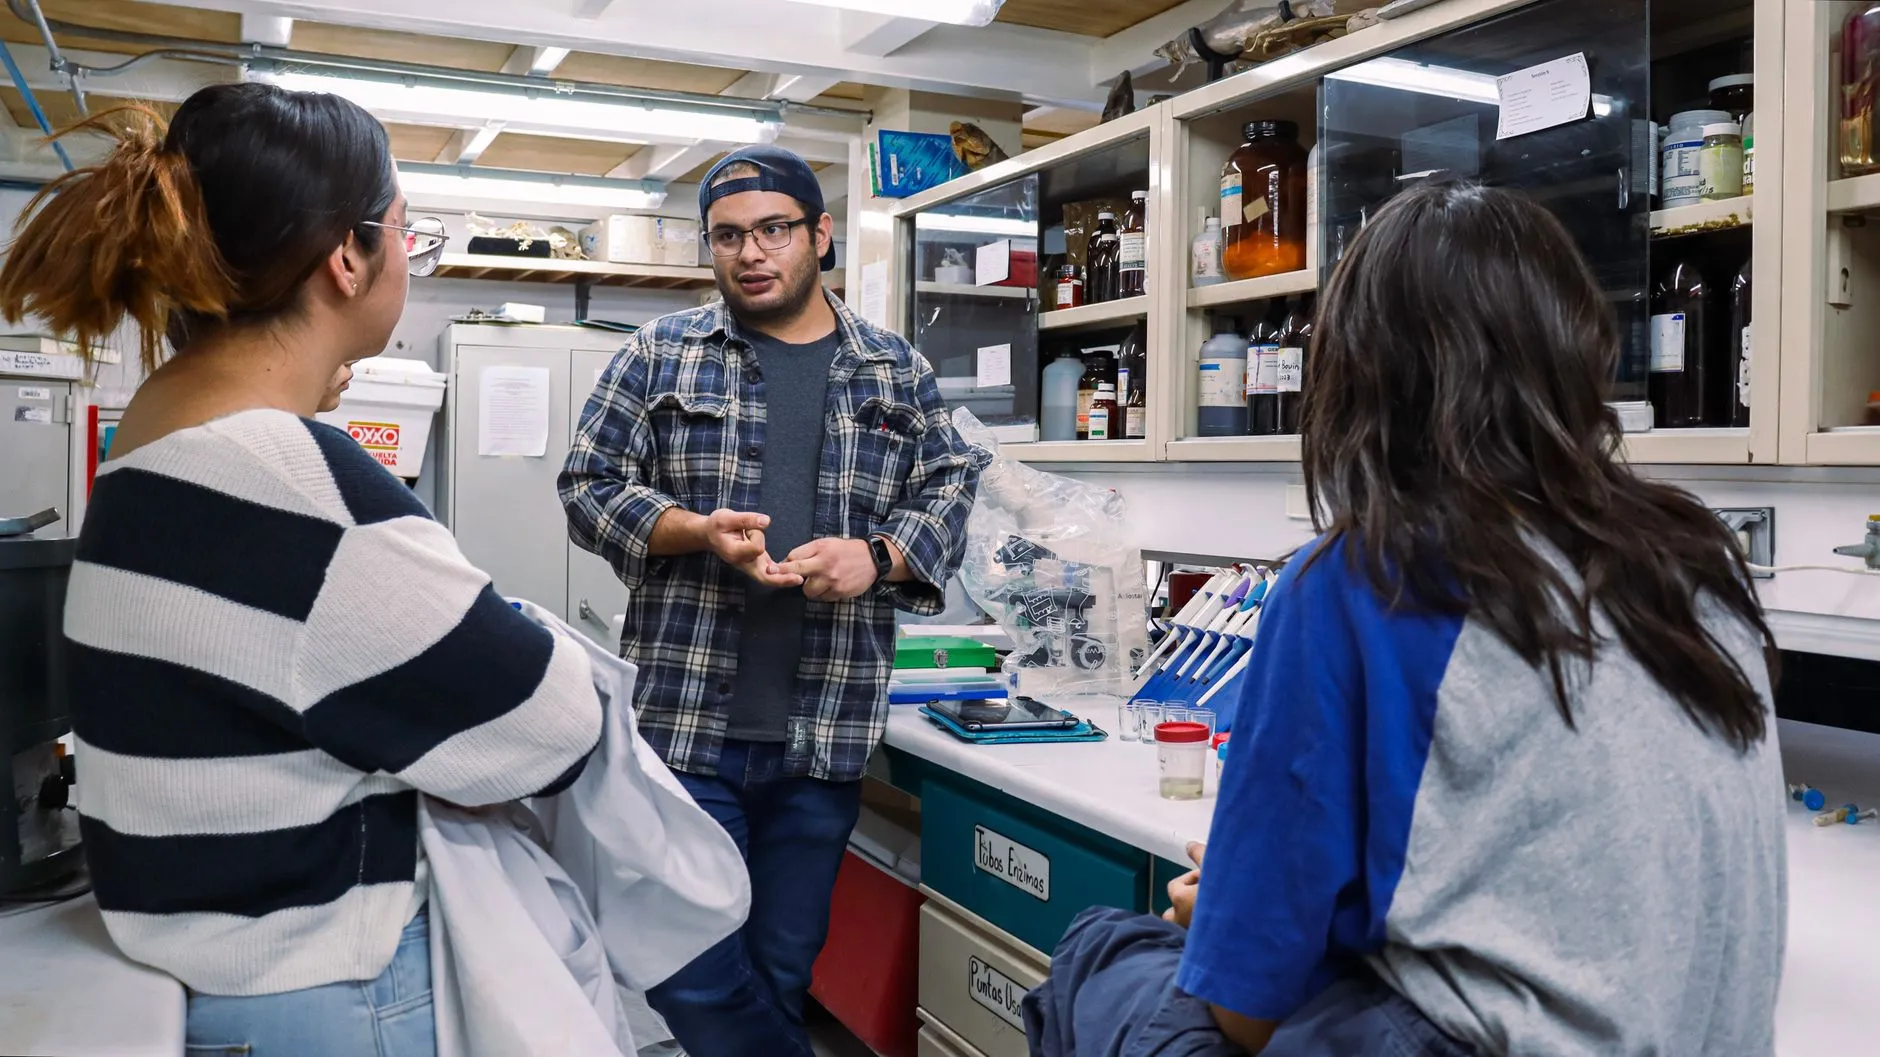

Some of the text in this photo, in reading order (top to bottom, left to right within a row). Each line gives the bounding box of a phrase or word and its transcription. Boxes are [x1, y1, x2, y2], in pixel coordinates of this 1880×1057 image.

[348, 427, 398, 446] OXXO
[975, 827, 1044, 894] Tubos Enzimas
[971, 960, 1003, 1005] Puntas
